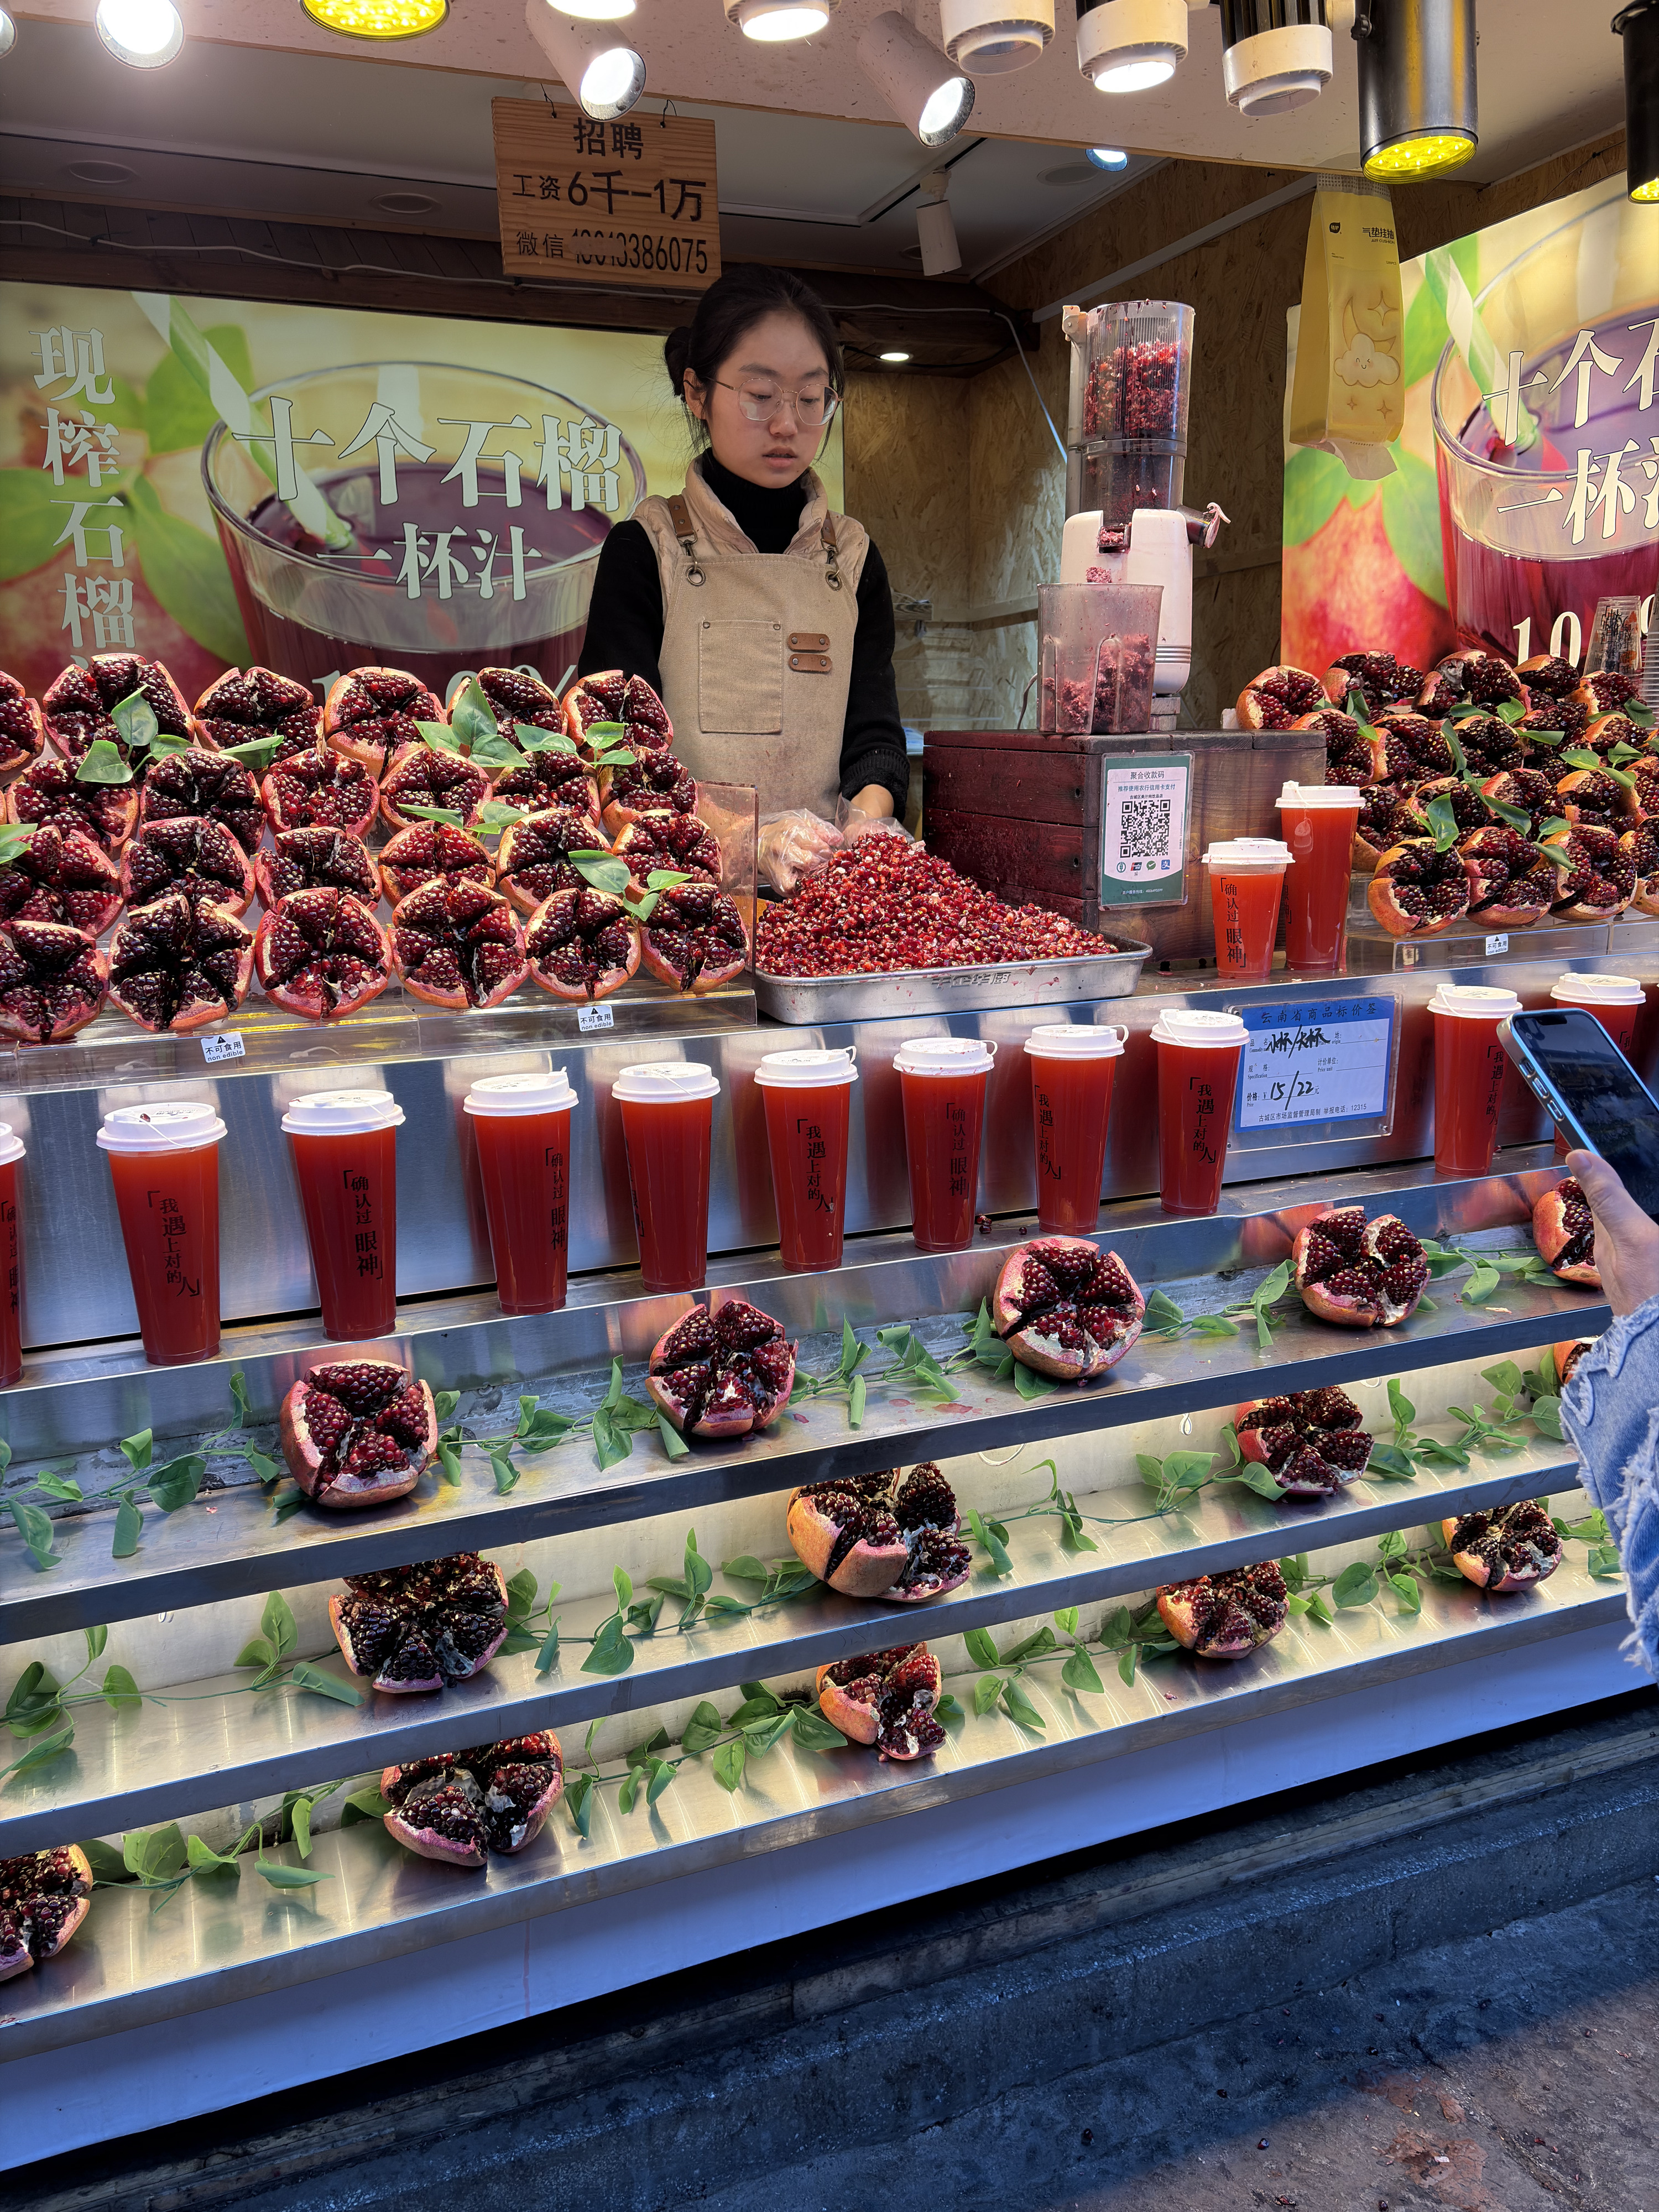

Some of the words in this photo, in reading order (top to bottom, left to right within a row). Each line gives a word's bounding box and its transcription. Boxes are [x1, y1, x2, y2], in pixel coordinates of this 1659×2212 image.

[573, 117, 644, 160] 招聘
[1362, 227, 1395, 239] 气垫挂抽
[516, 231, 564, 258] 微信
[231, 395, 623, 512] 十个石榴
[28, 324, 135, 670] 现榨石榴
[315, 521, 542, 601] 一杯汁
[1130, 770, 1165, 780] 聚合收款码
[1118, 783, 1176, 792] 推荐使用农行信用卡支付
[1487, 940, 1507, 950] 不可食用
[580, 1013, 611, 1025] 不可食用
[1261, 1002, 1377, 1024] 云南省商品标价签
[205, 1041, 242, 1055] 不可食用
[222, 1050, 243, 1058] edible
[1270, 1070, 1314, 1111] 15/22
[1258, 1108, 1321, 1122] 古城区市场监督管理局制
[1323, 1105, 1348, 1115] 举报电话：
